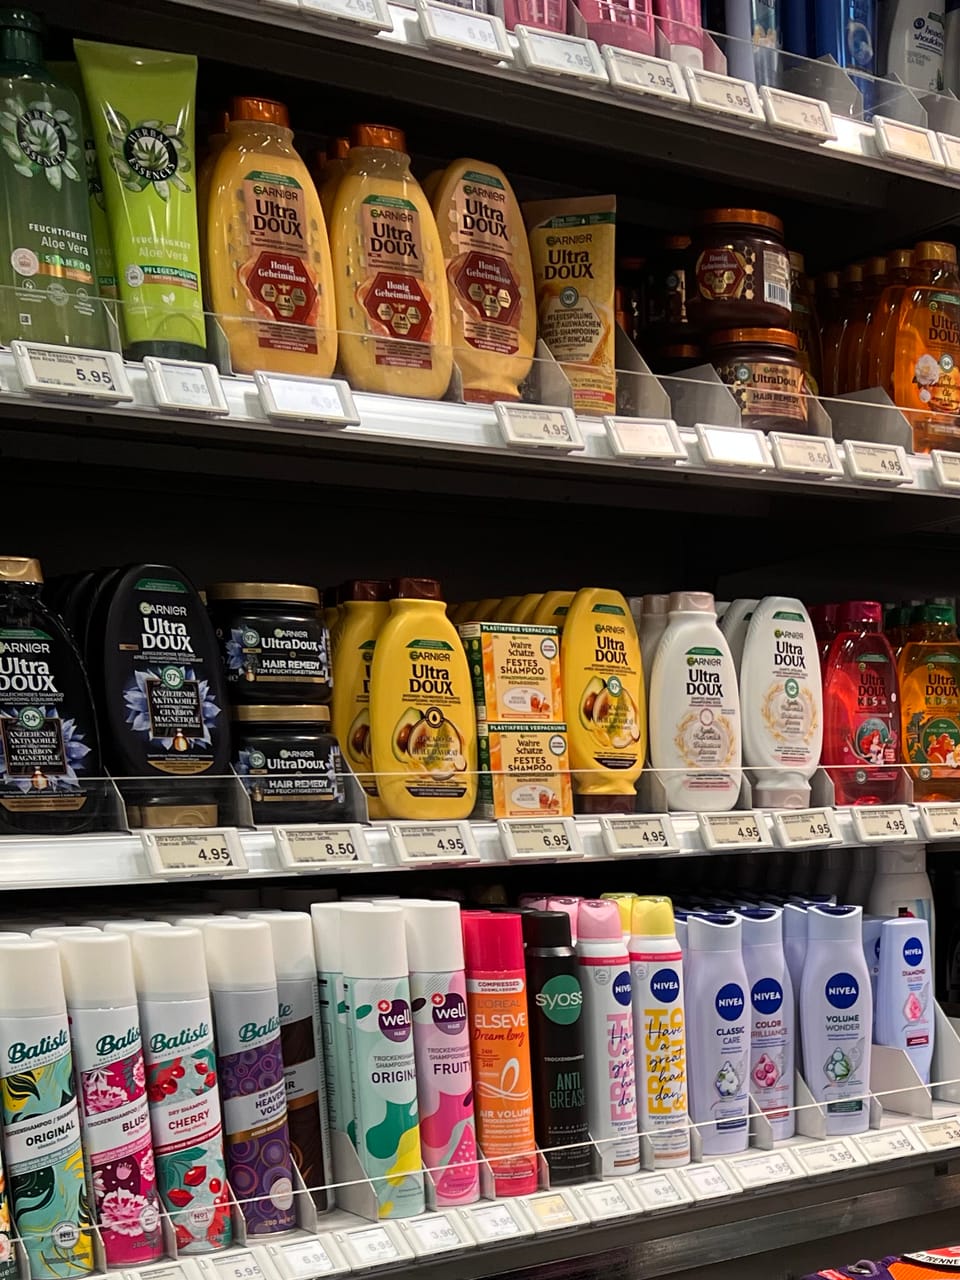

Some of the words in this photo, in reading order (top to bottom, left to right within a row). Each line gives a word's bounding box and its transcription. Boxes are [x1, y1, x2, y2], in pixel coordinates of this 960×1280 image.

[649, 72, 673, 87] 2.95
[726, 92, 750, 108] 5.95
[19, 141, 66, 167] ESSENCES
[128, 156, 177, 181] ESSENCES
[254, 197, 299, 222] Ultra
[464, 197, 505, 224] Ultra
[28, 223, 88, 242] FEUCHTIGKEIT
[253, 215, 303, 240] DOUX
[372, 221, 413, 243] Ultra
[463, 215, 509, 241] DOUX
[41, 236, 67, 250] Aloe
[67, 240, 89, 256] Vera
[370, 236, 418, 259] DOUX
[548, 249, 590, 267] Ultra
[270, 260, 296, 274] Honig
[543, 263, 595, 280] DOUX
[257, 266, 308, 285] Geheimnisse
[387, 280, 410, 294] Honig
[931, 315, 960, 333] Ultra
[76, 366, 112, 386] 5.95
[542, 422, 569, 437] 4.95
[880, 459, 901, 472] 4.95
[139, 602, 187, 617] GARNIER
[143, 617, 187, 636] Ultra
[482, 625, 521, 633] PLASTIKFREIE
[521, 627, 557, 635] VERPACKUNG
[595, 624, 625, 635] GARNIER
[774, 629, 804, 640] GARNIER
[141, 633, 194, 653] DOUX
[510, 641, 532, 649] Wahre
[597, 636, 625, 651] Ultra
[776, 641, 803, 656] Ultra
[409, 651, 450, 662] GARNIER
[506, 659, 538, 667] FESTES
[595, 650, 628, 666] DOUX
[687, 656, 722, 667] GARNIER
[774, 653, 806, 669] DOUX
[262, 659, 286, 669] HAIR
[288, 660, 320, 670] REMEDY
[500, 666, 544, 675] SHAMPOO
[412, 664, 449, 680] Ultra
[688, 669, 720, 684] Ultra
[928, 672, 957, 686] Ultra
[409, 678, 454, 696] DOUX
[860, 673, 885, 687] Ultra
[686, 682, 724, 697] DOUX
[858, 685, 887, 698] DOUX
[925, 684, 959, 697] DOUX
[518, 739, 540, 748] Wahre
[508, 764, 552, 772] SHAMPOO
[513, 757, 546, 765] FESTES
[269, 780, 292, 789] HAIR
[294, 779, 328, 789] REMEDY
[738, 825, 760, 838] 4.95
[810, 822, 830, 835] 4.95
[886, 819, 905, 832] 4.95
[437, 837, 464, 851] 4.95
[543, 834, 569, 847] 6.95
[643, 831, 666, 844] 4.95
[198, 848, 230, 861] 4.95
[325, 843, 356, 856] 8.50
[905, 948, 922, 957] NIVEA
[653, 980, 679, 991] NIVEA
[828, 986, 857, 996] NIVEA
[535, 991, 583, 1013] syoss
[718, 997, 743, 1008] NIVEA
[753, 991, 781, 1001] NIVEA
[382, 1009, 411, 1026] well
[436, 1002, 466, 1020] well
[475, 1012, 526, 1029] ELSEVE
[755, 1020, 782, 1029] COLOR
[826, 1014, 860, 1023] VOLUME
[648, 1018, 683, 1041] Have
[716, 1026, 745, 1036] CLASSIC
[825, 1023, 860, 1032] WONDER
[150, 1022, 210, 1053] Batiste
[473, 1028, 505, 1043] Dream
[506, 1026, 526, 1048] long
[722, 1035, 741, 1045] CARE
[8, 1028, 69, 1064] Batiste
[644, 1007, 672, 1115] FRESH
[649, 1046, 684, 1072] great
[556, 1071, 583, 1091] ANTI
[168, 1108, 180, 1117] DRY
[168, 1108, 210, 1130] CHERRY
[480, 1110, 494, 1119] AIR
[25, 1119, 76, 1147] ORIGINAL
[889, 1139, 910, 1150] 3.95
[829, 1151, 850, 1163] 3.95
[234, 1266, 261, 1278] 5.95
